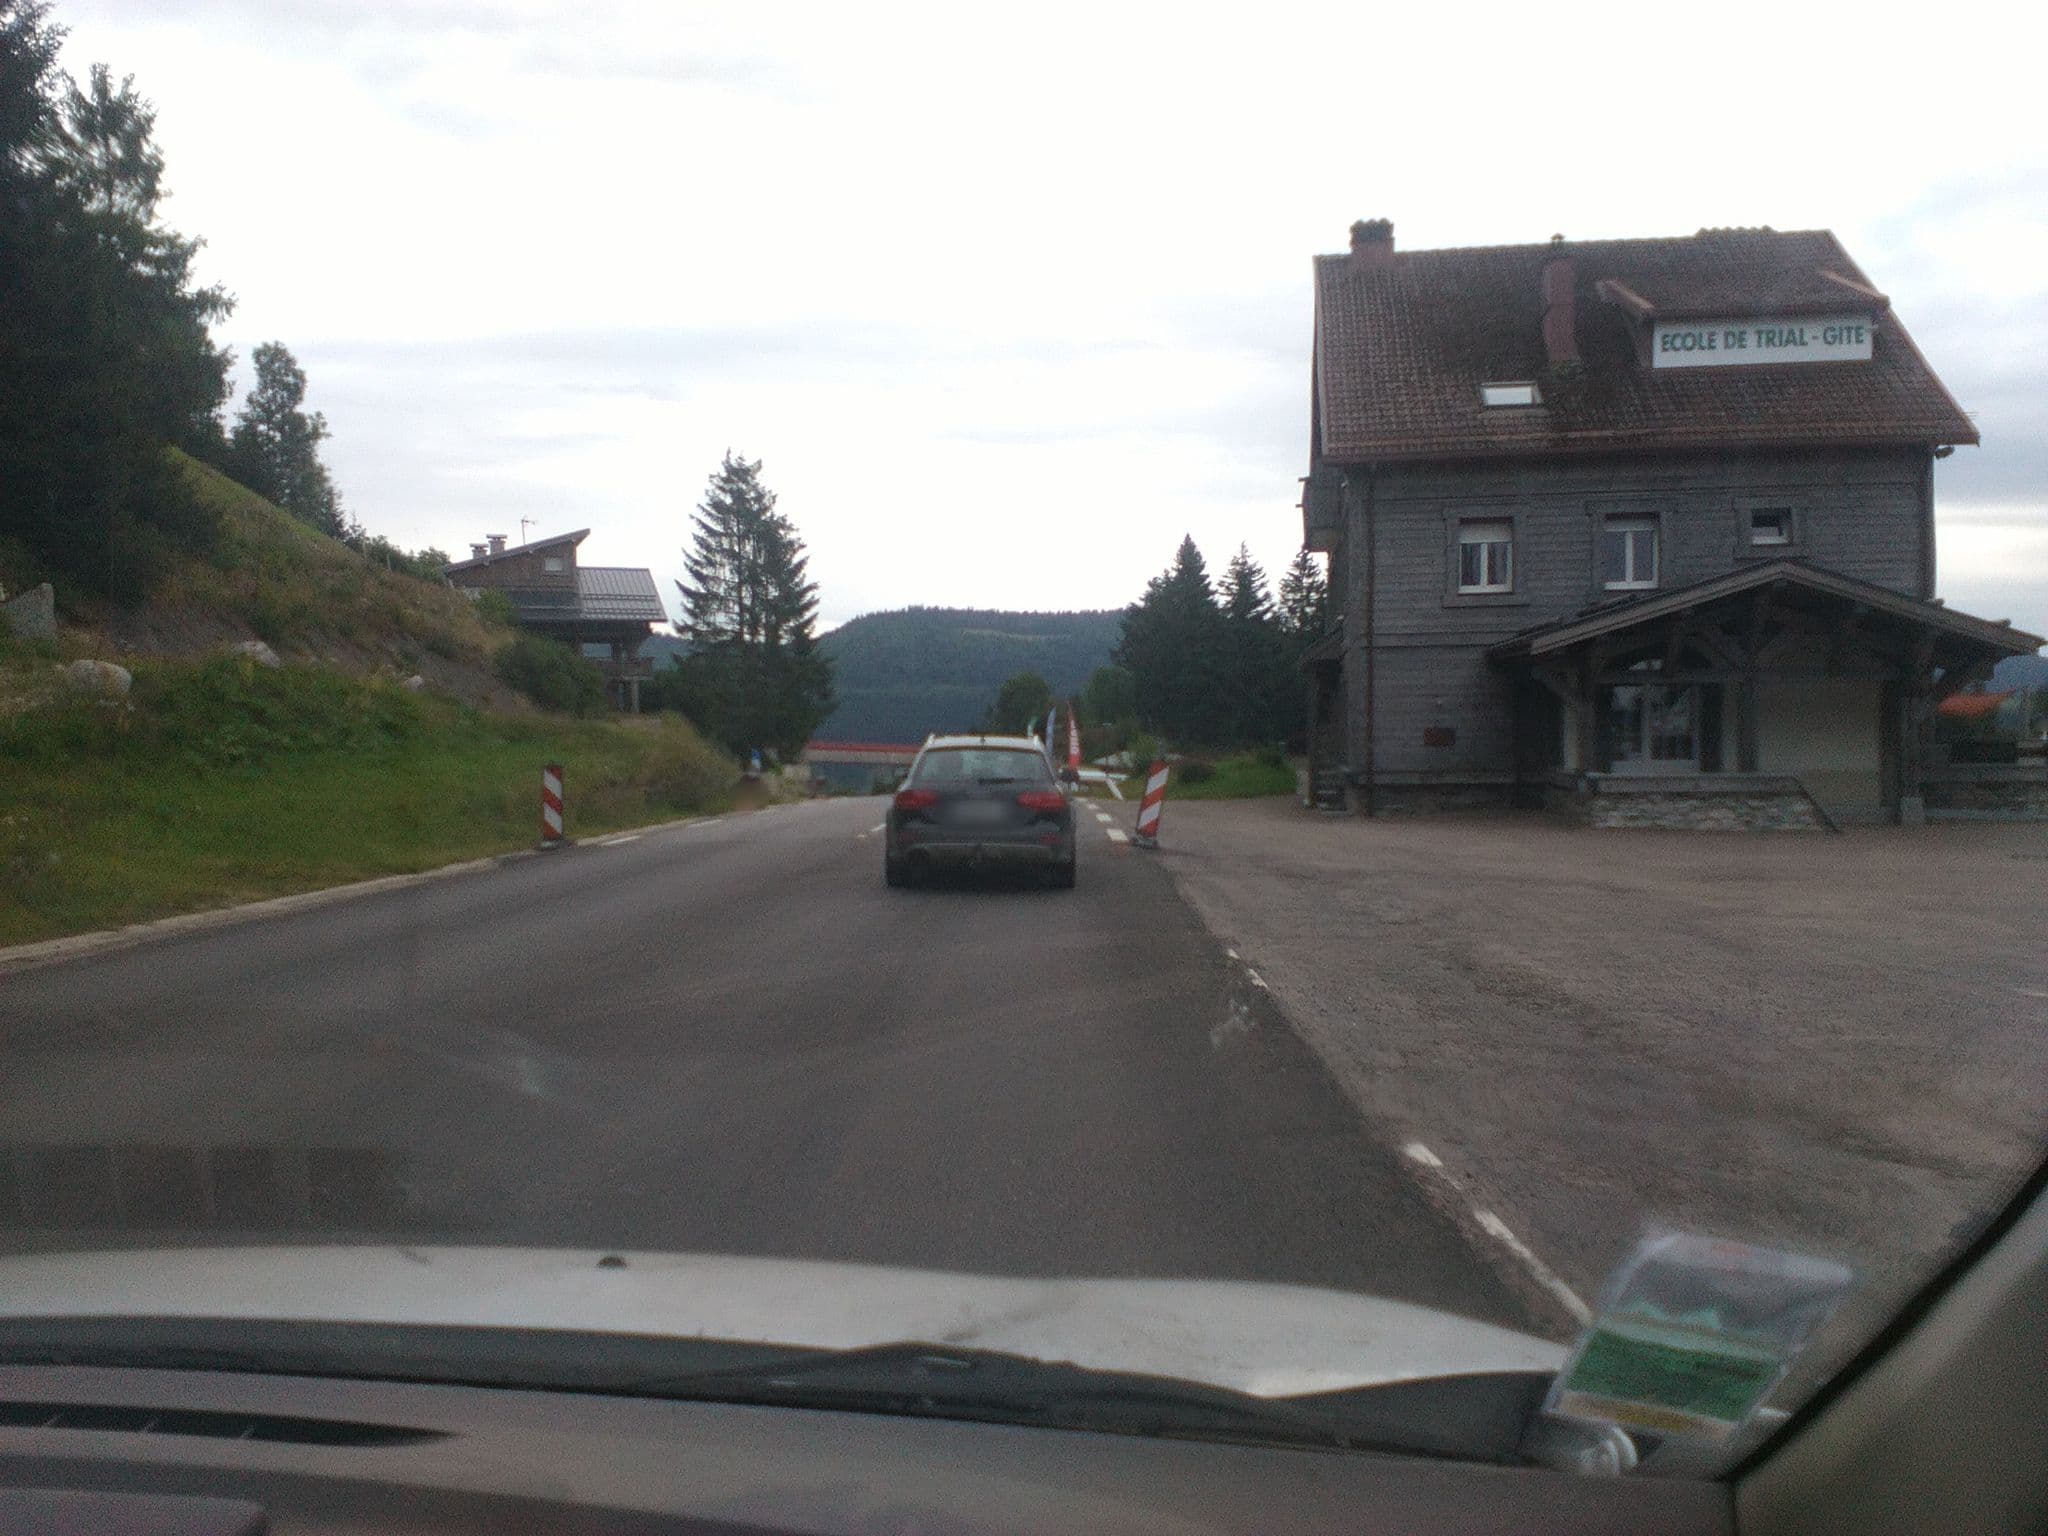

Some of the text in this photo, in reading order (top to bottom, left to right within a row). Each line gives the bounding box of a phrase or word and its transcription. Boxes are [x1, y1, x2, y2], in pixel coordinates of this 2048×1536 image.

[1661, 331, 1717, 352] ECOLE
[1723, 330, 1747, 349] DE
[1754, 327, 1808, 348] TRIAL
[1822, 325, 1864, 345] GITE
